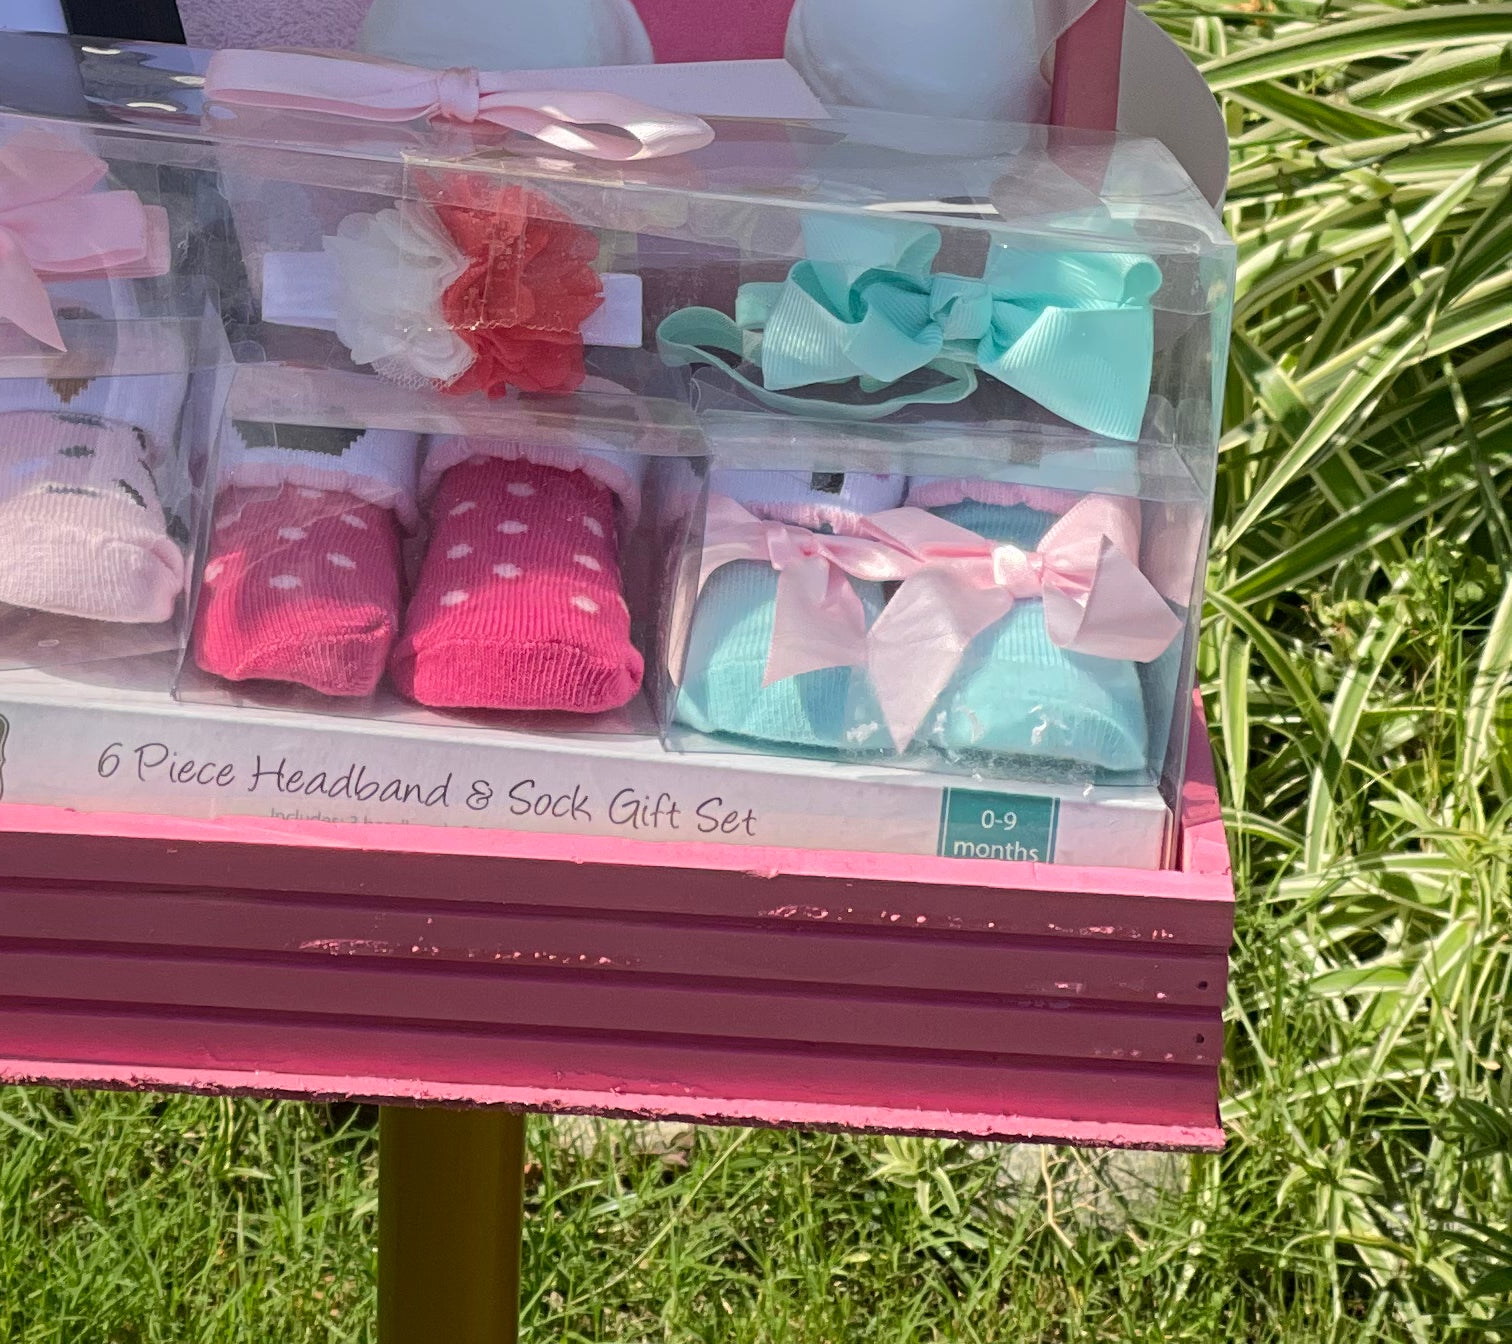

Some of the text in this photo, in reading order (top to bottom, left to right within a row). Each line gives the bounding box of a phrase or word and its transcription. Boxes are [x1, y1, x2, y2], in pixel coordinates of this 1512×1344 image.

[97, 742, 758, 836] 6 Piece Headband & Sock Gift Set
[981, 809, 1018, 831] 0-9
[953, 840, 1040, 862] months
